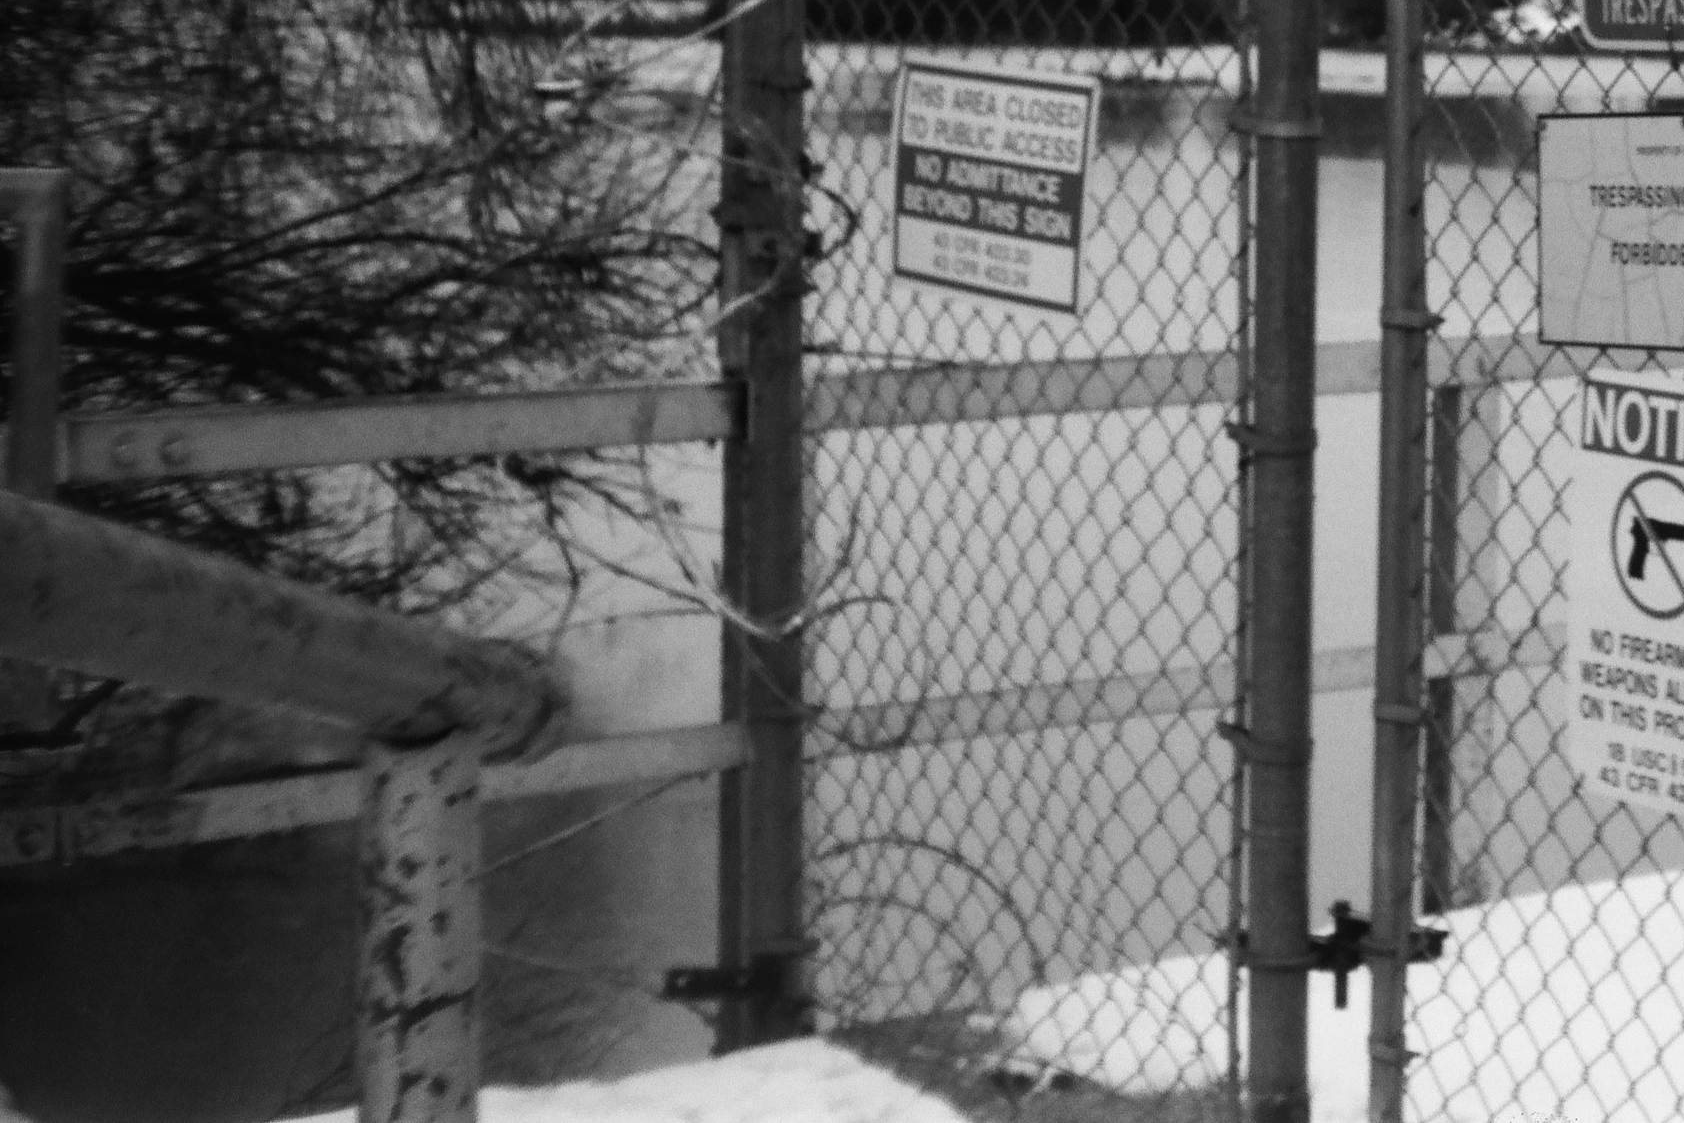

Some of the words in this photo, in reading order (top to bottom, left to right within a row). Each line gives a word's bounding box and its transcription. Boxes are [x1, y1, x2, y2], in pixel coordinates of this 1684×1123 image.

[910, 80, 946, 110] THIS
[953, 87, 997, 116] AREA
[1005, 93, 1081, 129] CLOSED
[906, 111, 928, 139] TO
[933, 117, 995, 151] PUBLIC
[1002, 129, 1079, 165] ACCESS
[914, 152, 943, 183] NO
[946, 159, 1063, 204] ADMITTANCE
[902, 182, 973, 222] BEYOND
[977, 196, 1020, 231] THIS
[1024, 203, 1072, 240] SIGN
[1590, 628, 1614, 656] NO
[1579, 660, 1659, 700] WEAPONS
[1579, 692, 1605, 722] ON
[1609, 699, 1648, 733] THIS
